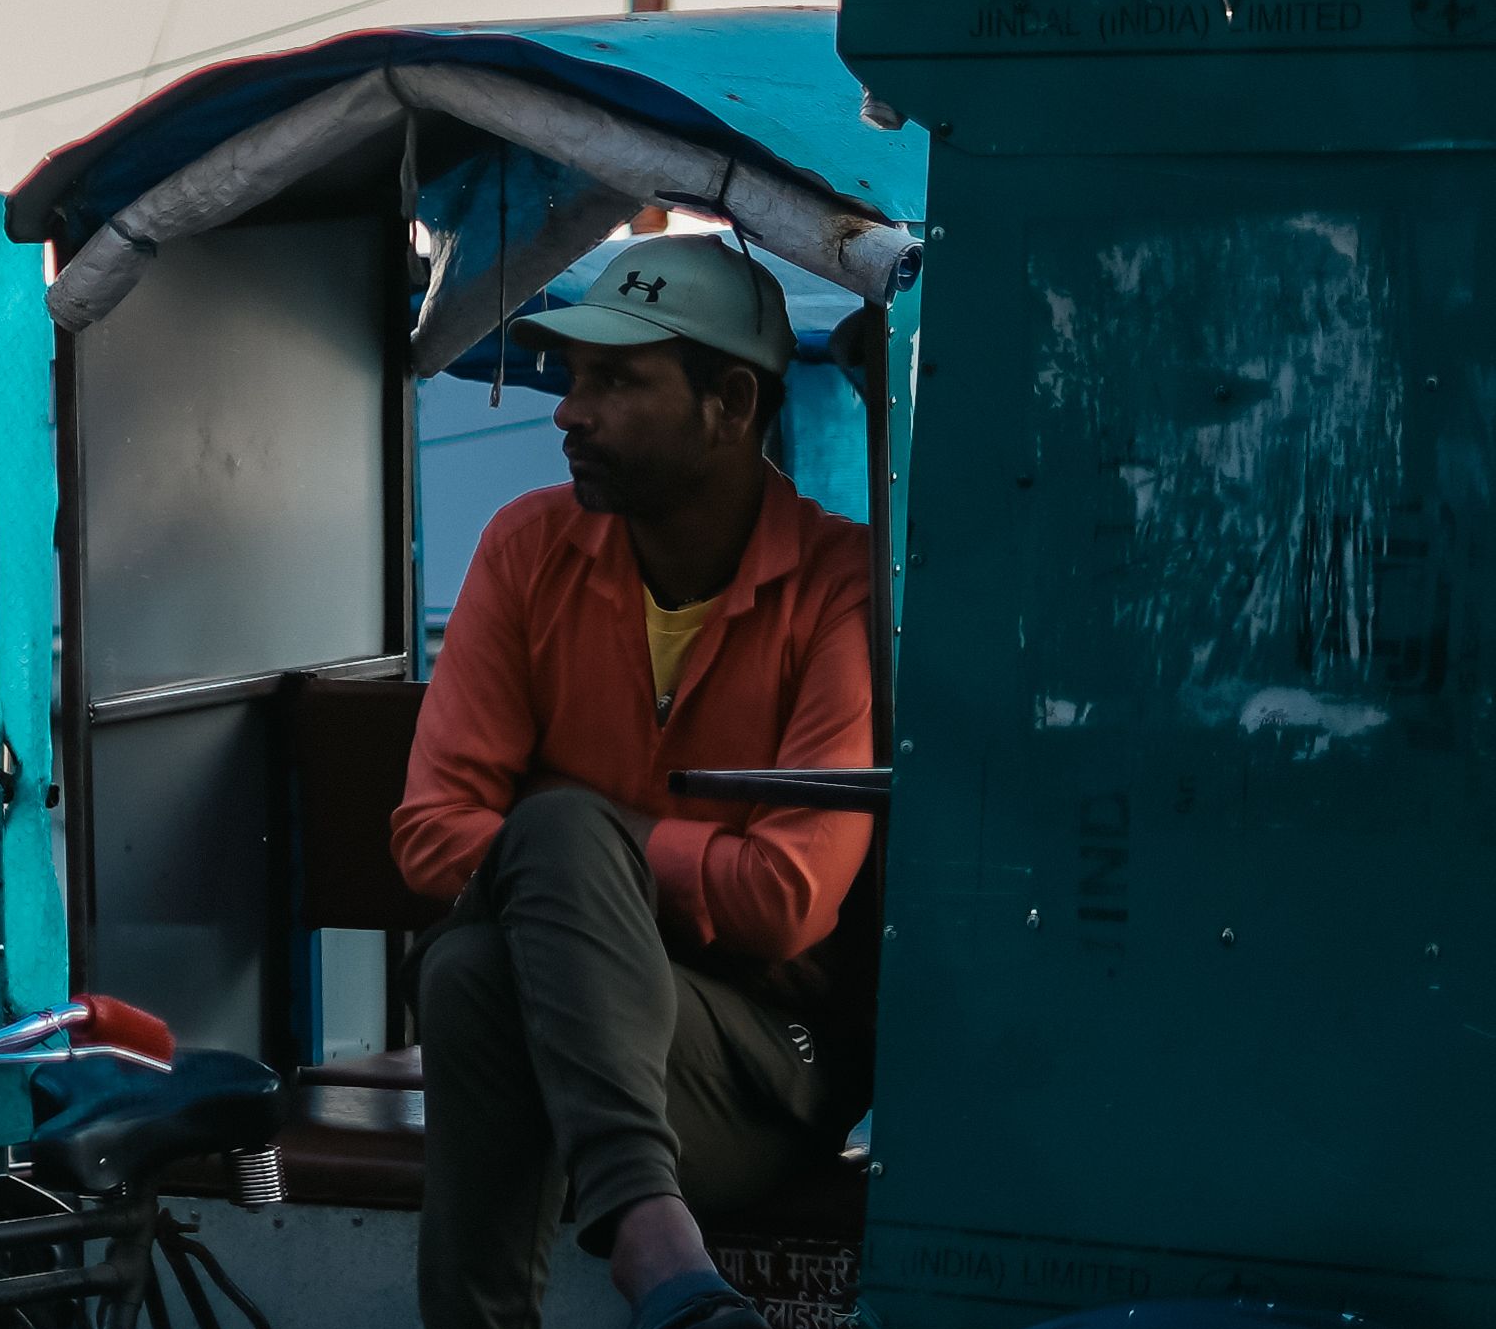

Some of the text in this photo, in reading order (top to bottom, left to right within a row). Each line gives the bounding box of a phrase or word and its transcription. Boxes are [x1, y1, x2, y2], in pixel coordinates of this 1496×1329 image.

[969, 5, 1080, 39] JINDAL
[1230, 1, 1362, 34] LIMITED
[1023, 1253, 1152, 1298] LIMITED
